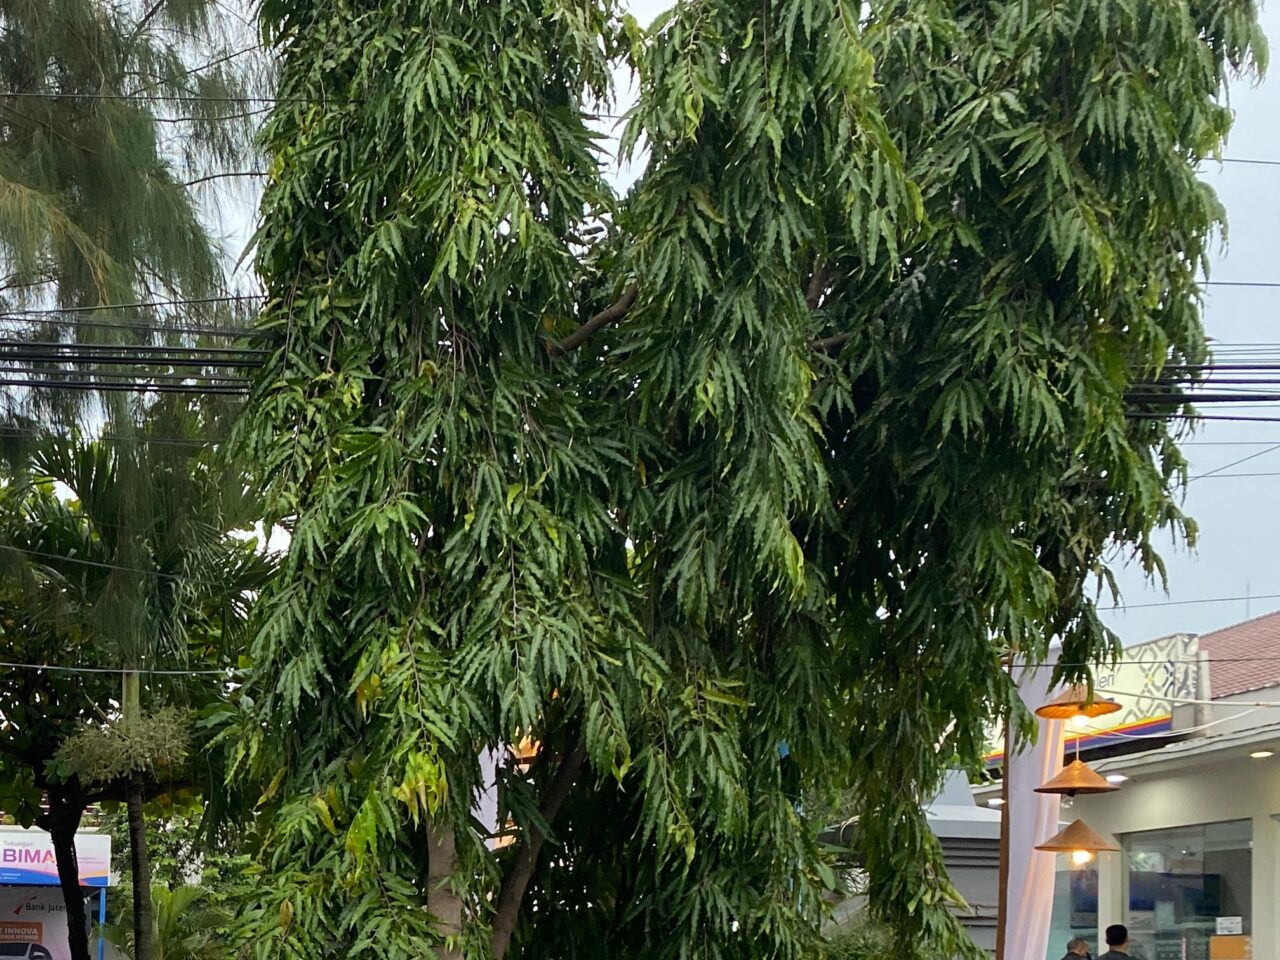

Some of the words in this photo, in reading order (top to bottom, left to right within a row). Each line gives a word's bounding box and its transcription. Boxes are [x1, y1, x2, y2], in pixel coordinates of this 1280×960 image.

[3, 848, 55, 864] BIMA
[25, 902, 46, 911] Bank
[5, 927, 38, 935] INNOVA
